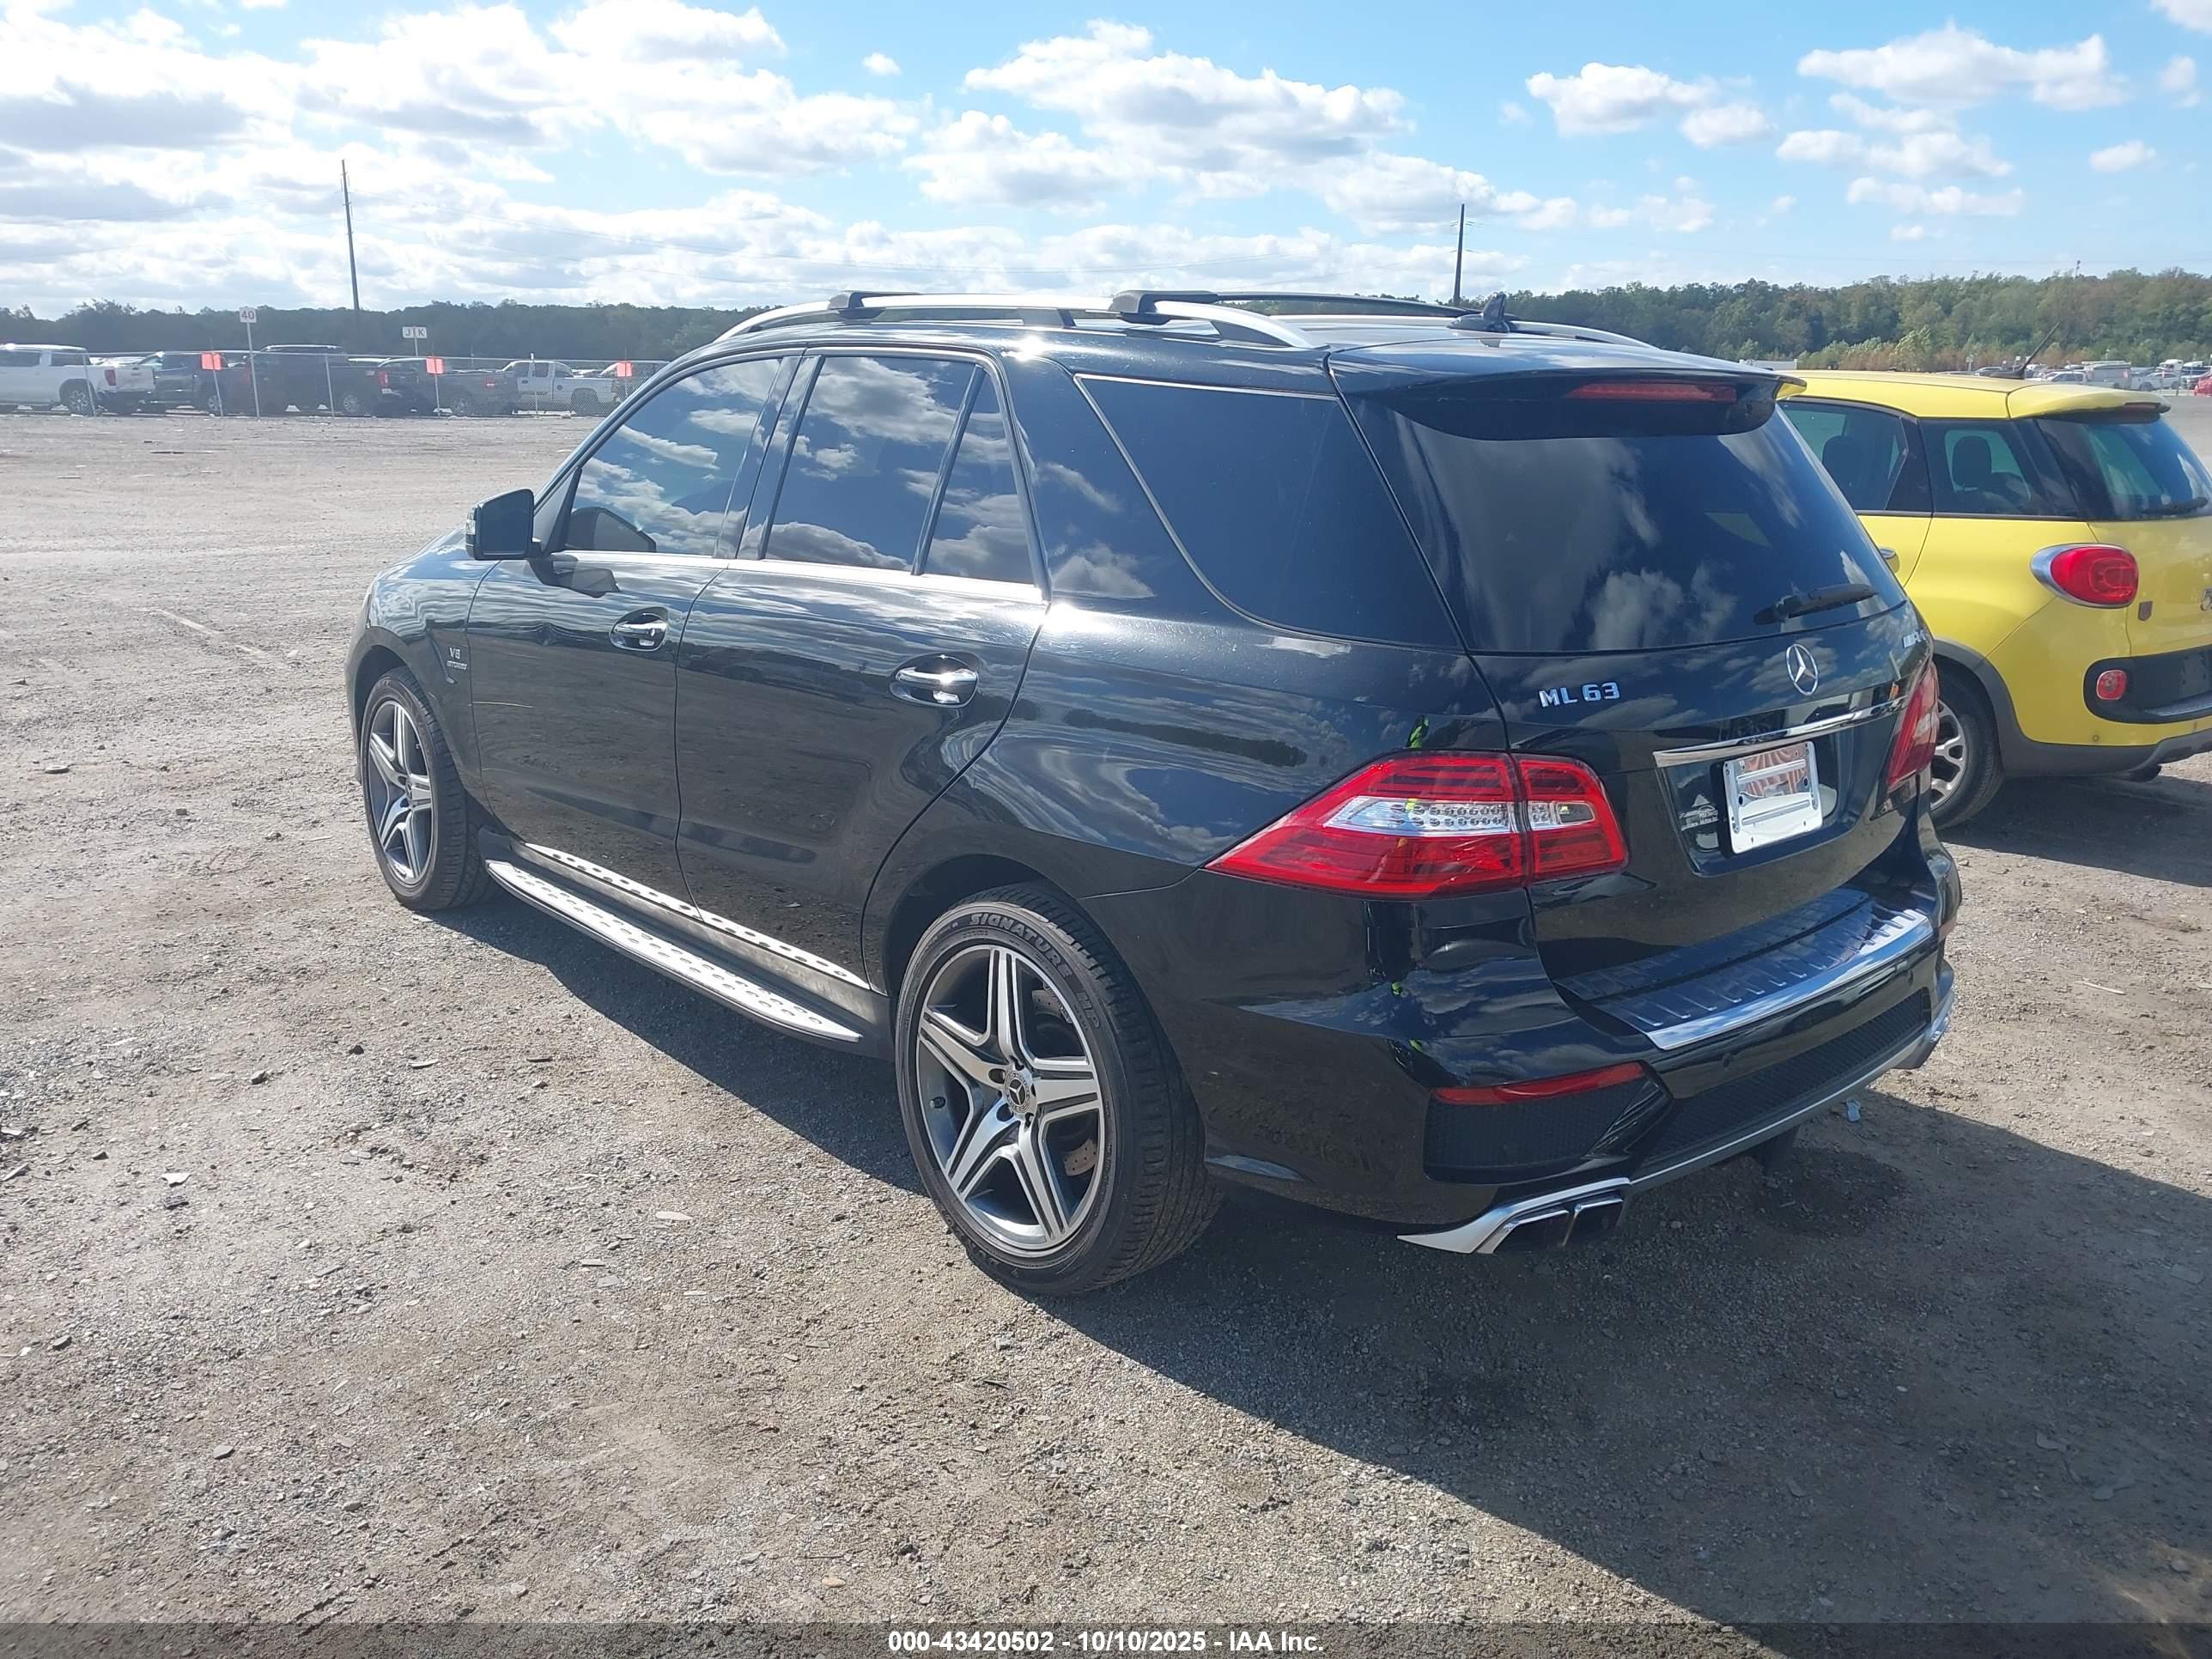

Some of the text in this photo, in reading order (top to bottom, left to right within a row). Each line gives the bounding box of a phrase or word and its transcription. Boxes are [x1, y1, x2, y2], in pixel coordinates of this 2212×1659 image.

[241, 311, 254, 320] 40
[449, 647, 461, 659] V8
[1539, 682, 1620, 708] ML 63
[969, 913, 1073, 977] SIGNATURE
[1077, 992, 1100, 1028] HP
